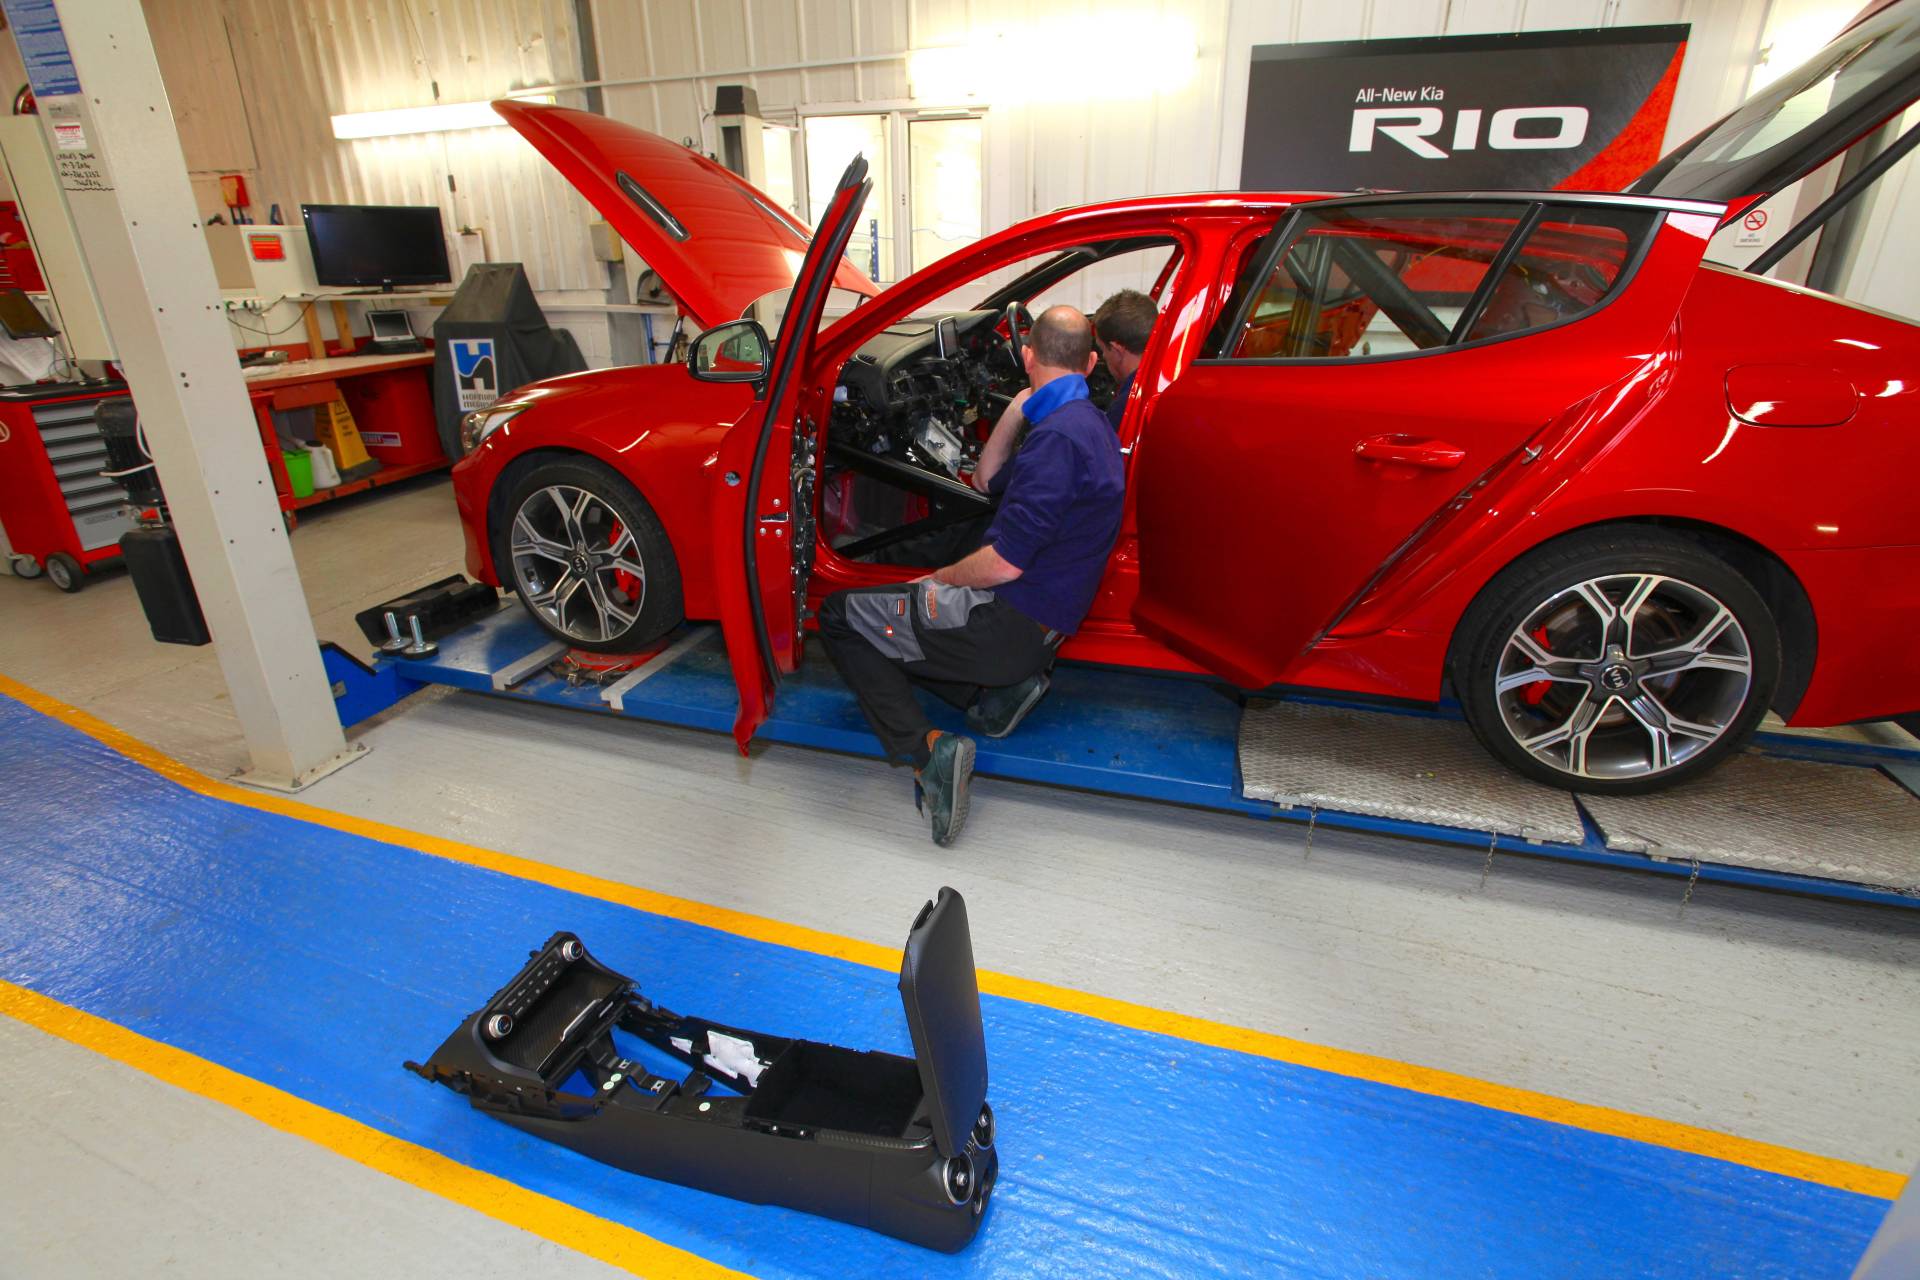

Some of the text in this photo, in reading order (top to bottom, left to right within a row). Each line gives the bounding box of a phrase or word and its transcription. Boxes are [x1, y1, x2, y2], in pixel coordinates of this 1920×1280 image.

[1355, 86, 1445, 103] All-New Kia
[1349, 106, 1589, 159] RIO
